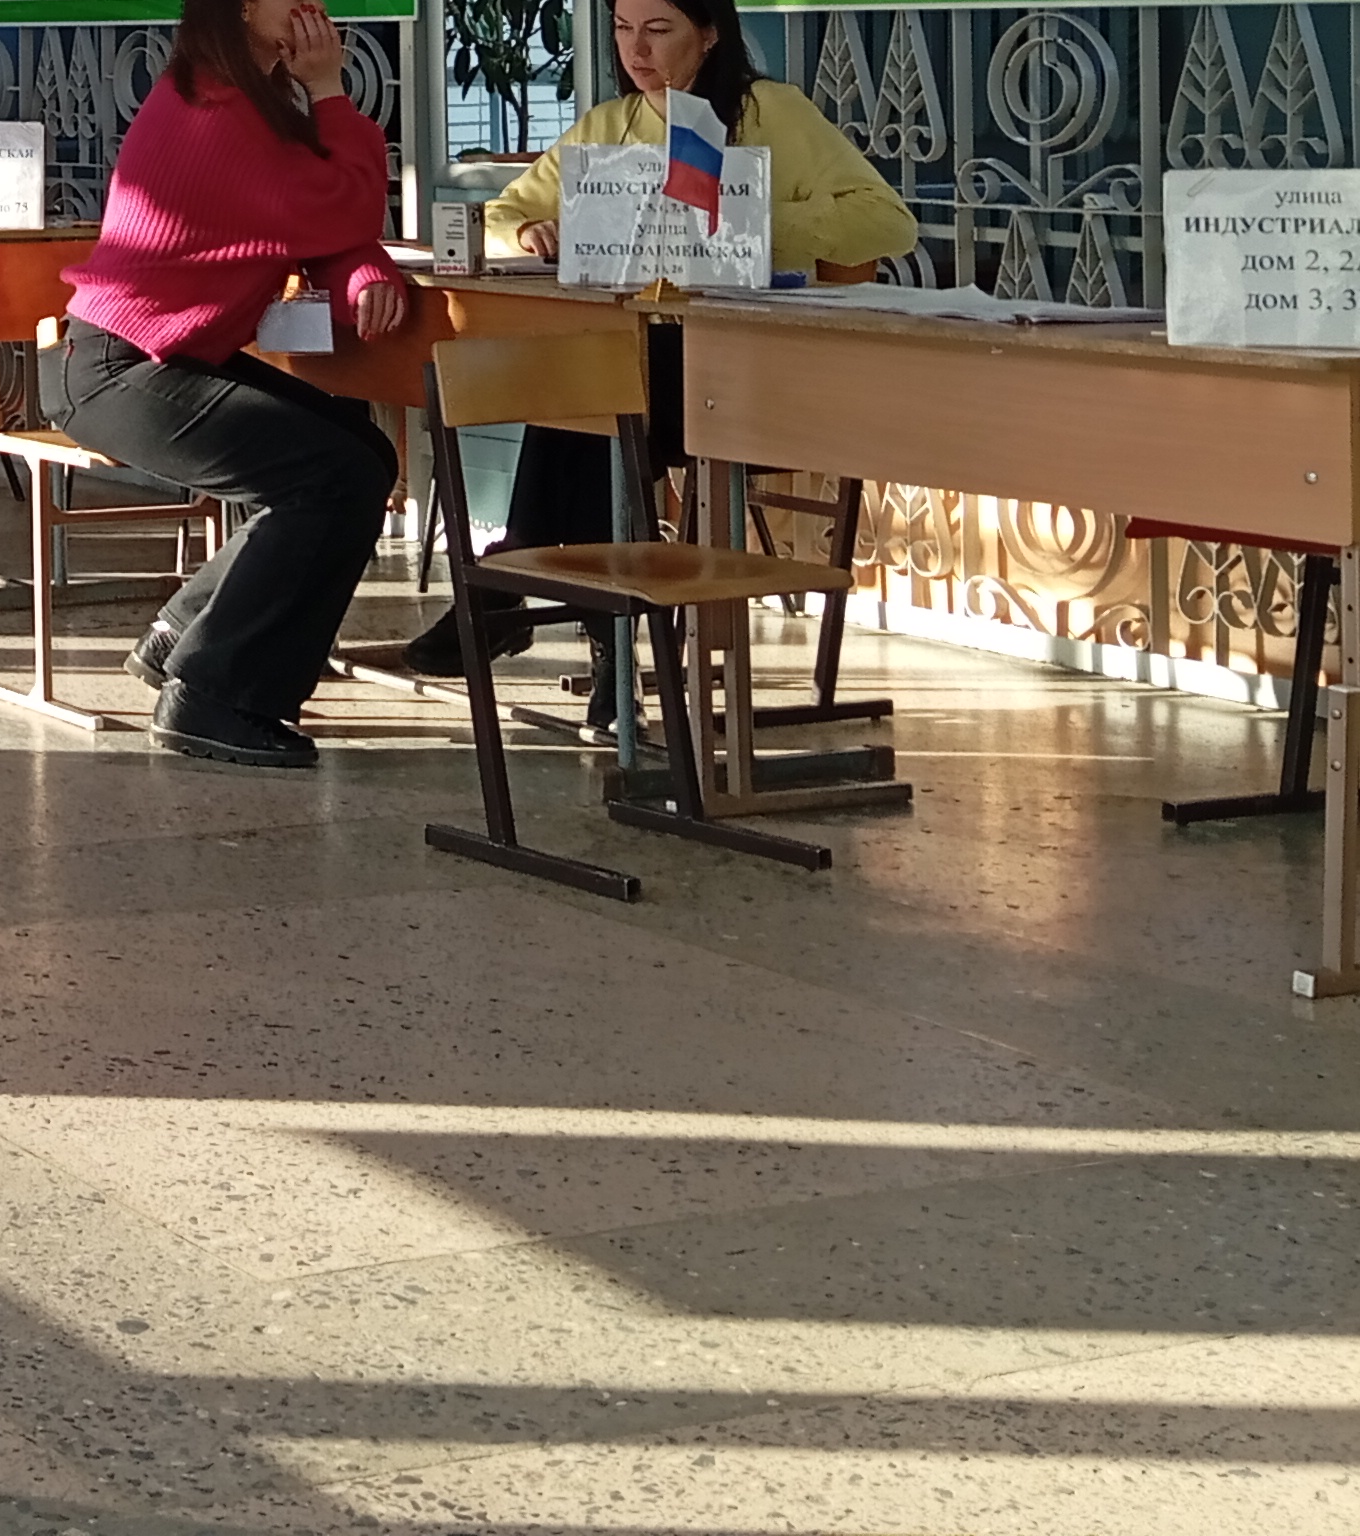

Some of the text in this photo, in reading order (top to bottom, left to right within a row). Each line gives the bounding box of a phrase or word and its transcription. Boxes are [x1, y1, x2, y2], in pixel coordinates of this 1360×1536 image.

[1274, 189, 1343, 208] улица
[637, 224, 688, 238] улица
[1184, 216, 1360, 238] ИНДУСТРИАЛ
[1240, 249, 1360, 273] дом 2, 2
[1244, 292, 1298, 312] дом
[1308, 288, 1332, 313] 3,
